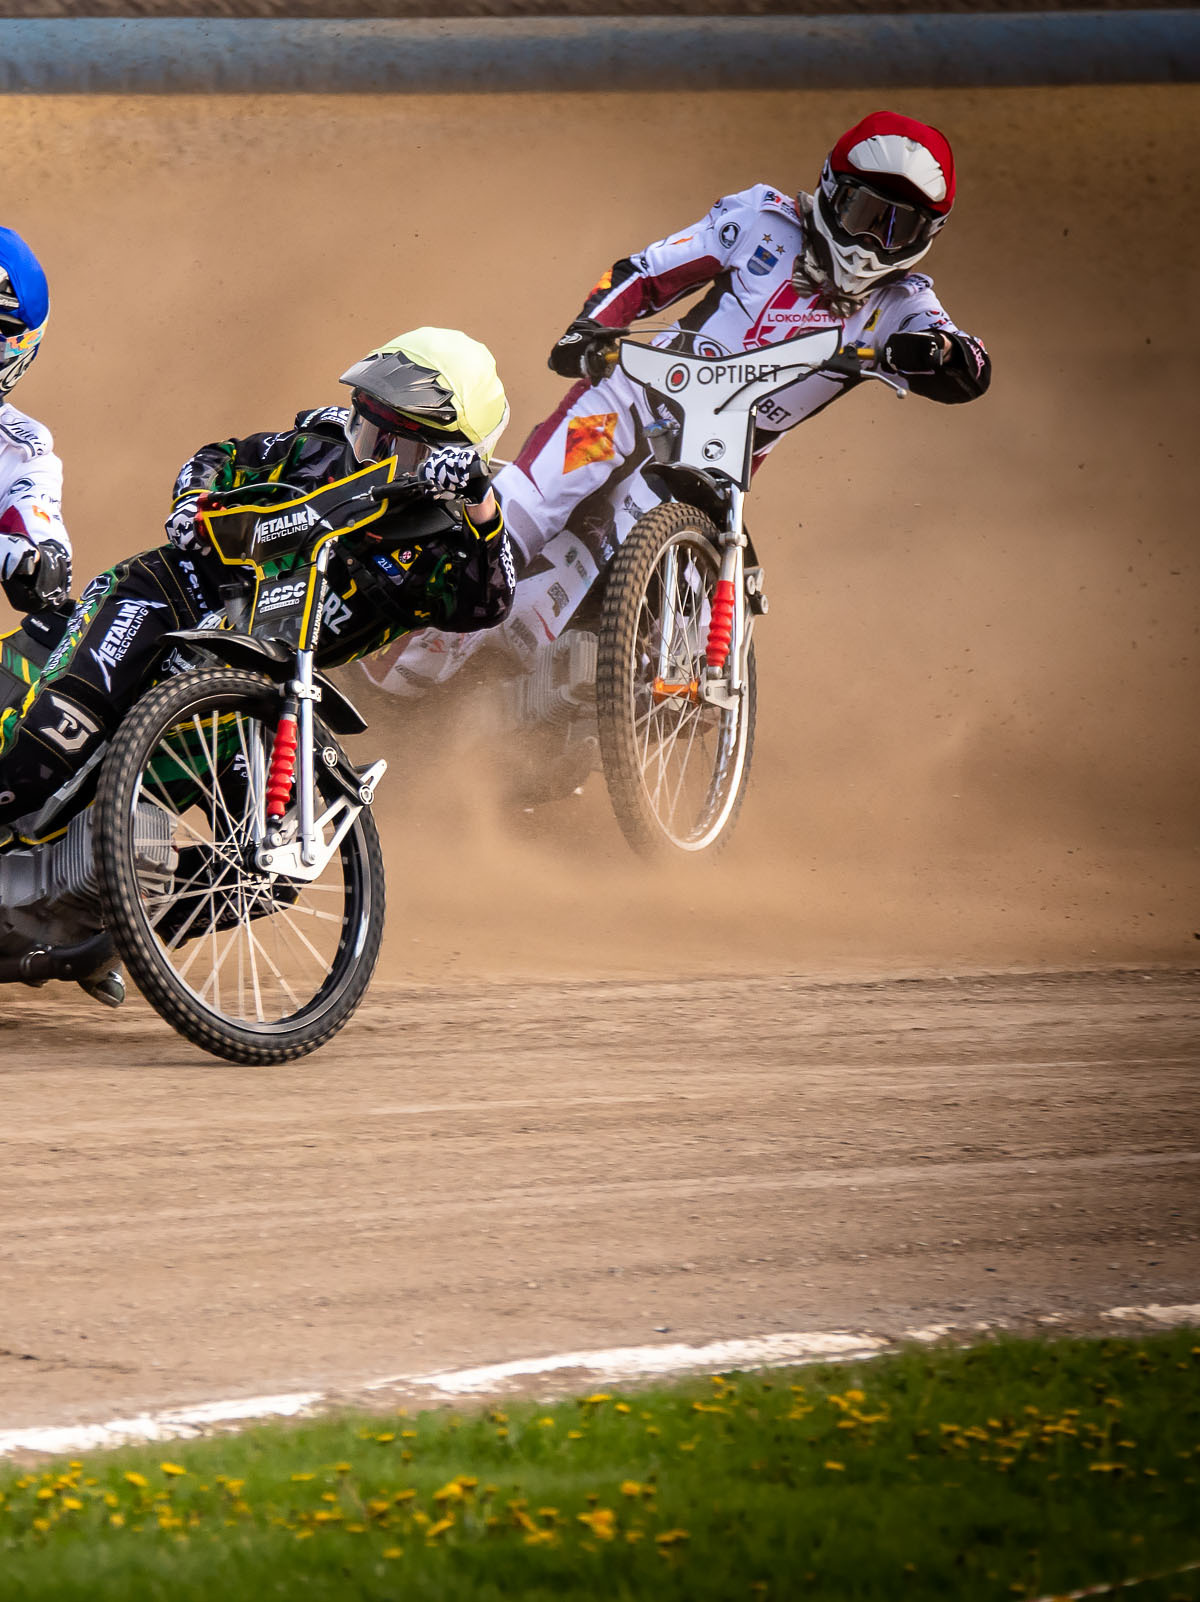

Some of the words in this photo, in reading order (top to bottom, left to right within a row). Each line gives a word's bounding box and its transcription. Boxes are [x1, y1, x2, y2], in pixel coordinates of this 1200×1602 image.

[697, 364, 780, 385] OPTIBET
[251, 504, 334, 556] METALIKA
[260, 523, 309, 543] RECYCLING
[257, 581, 307, 608] ACDC
[114, 606, 150, 662] RECYCLING
